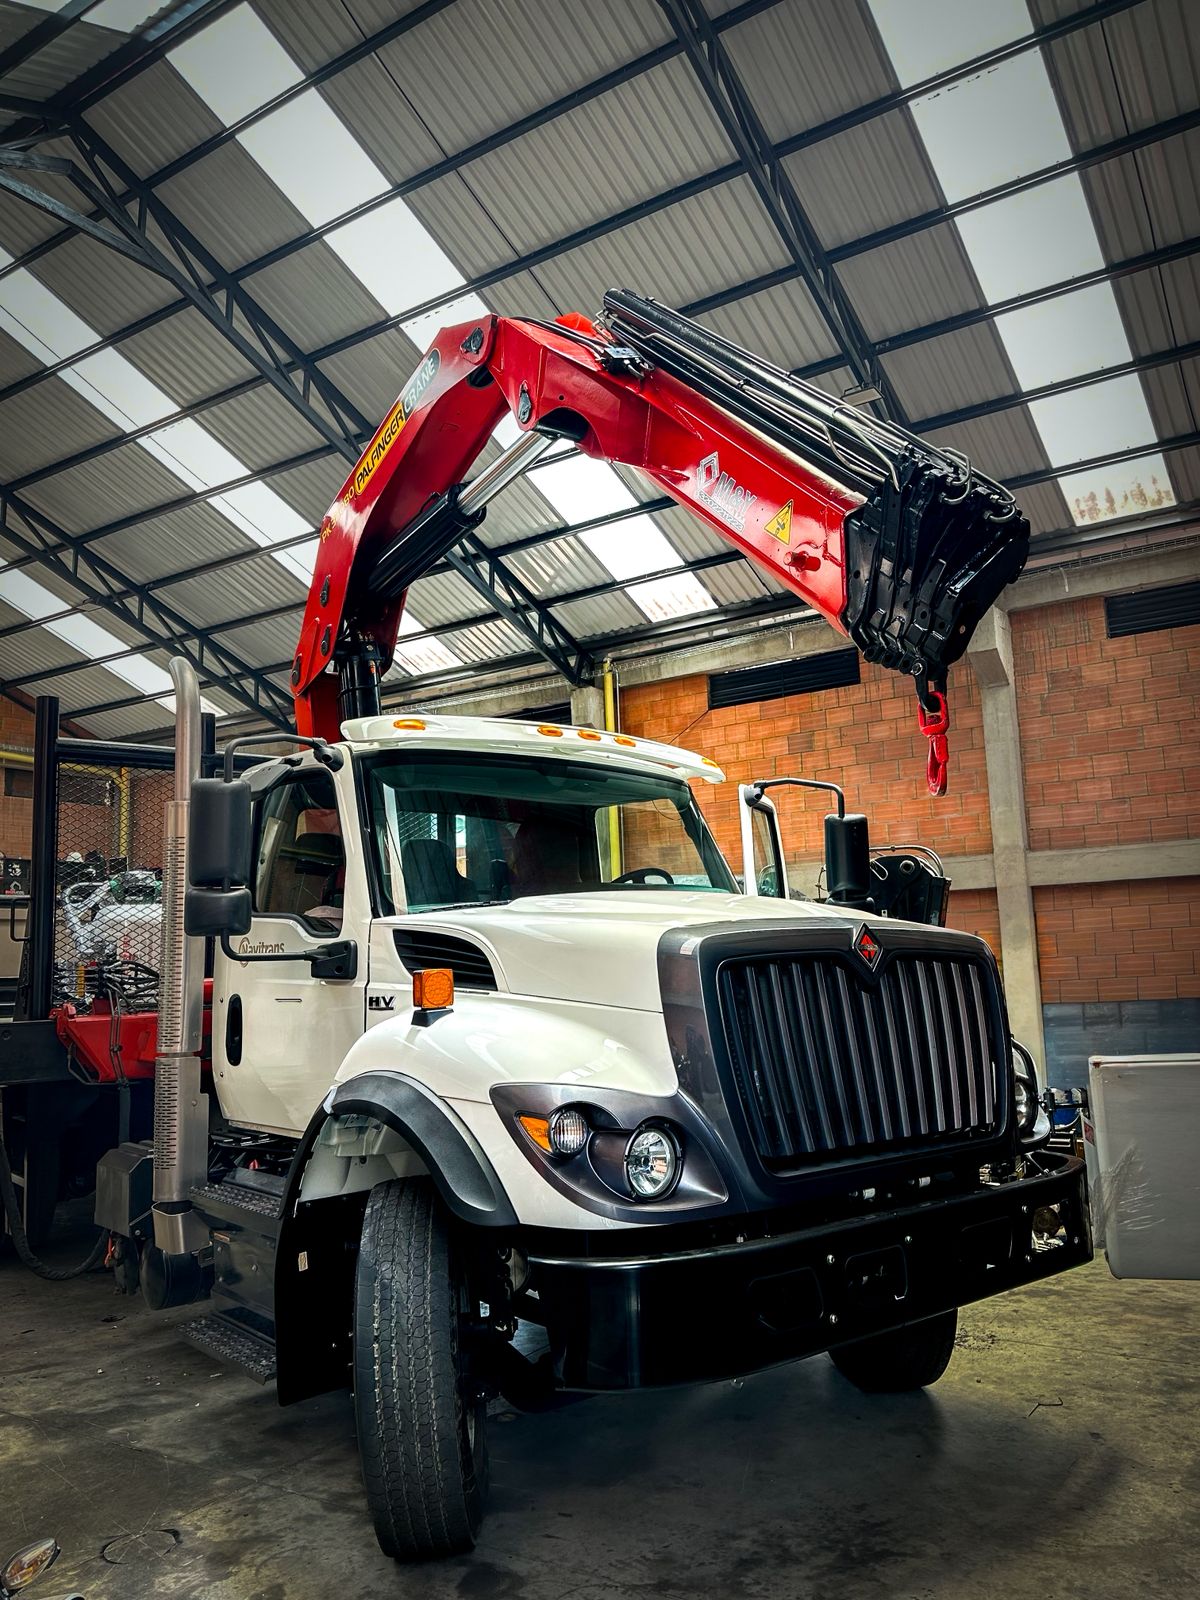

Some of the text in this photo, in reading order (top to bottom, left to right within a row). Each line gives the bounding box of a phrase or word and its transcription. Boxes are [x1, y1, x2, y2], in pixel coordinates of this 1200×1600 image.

[356, 357, 435, 490] PALFINGER CRANE
[331, 486, 355, 530] 380
[710, 471, 757, 516] M&Y
[369, 996, 395, 1009] HV
